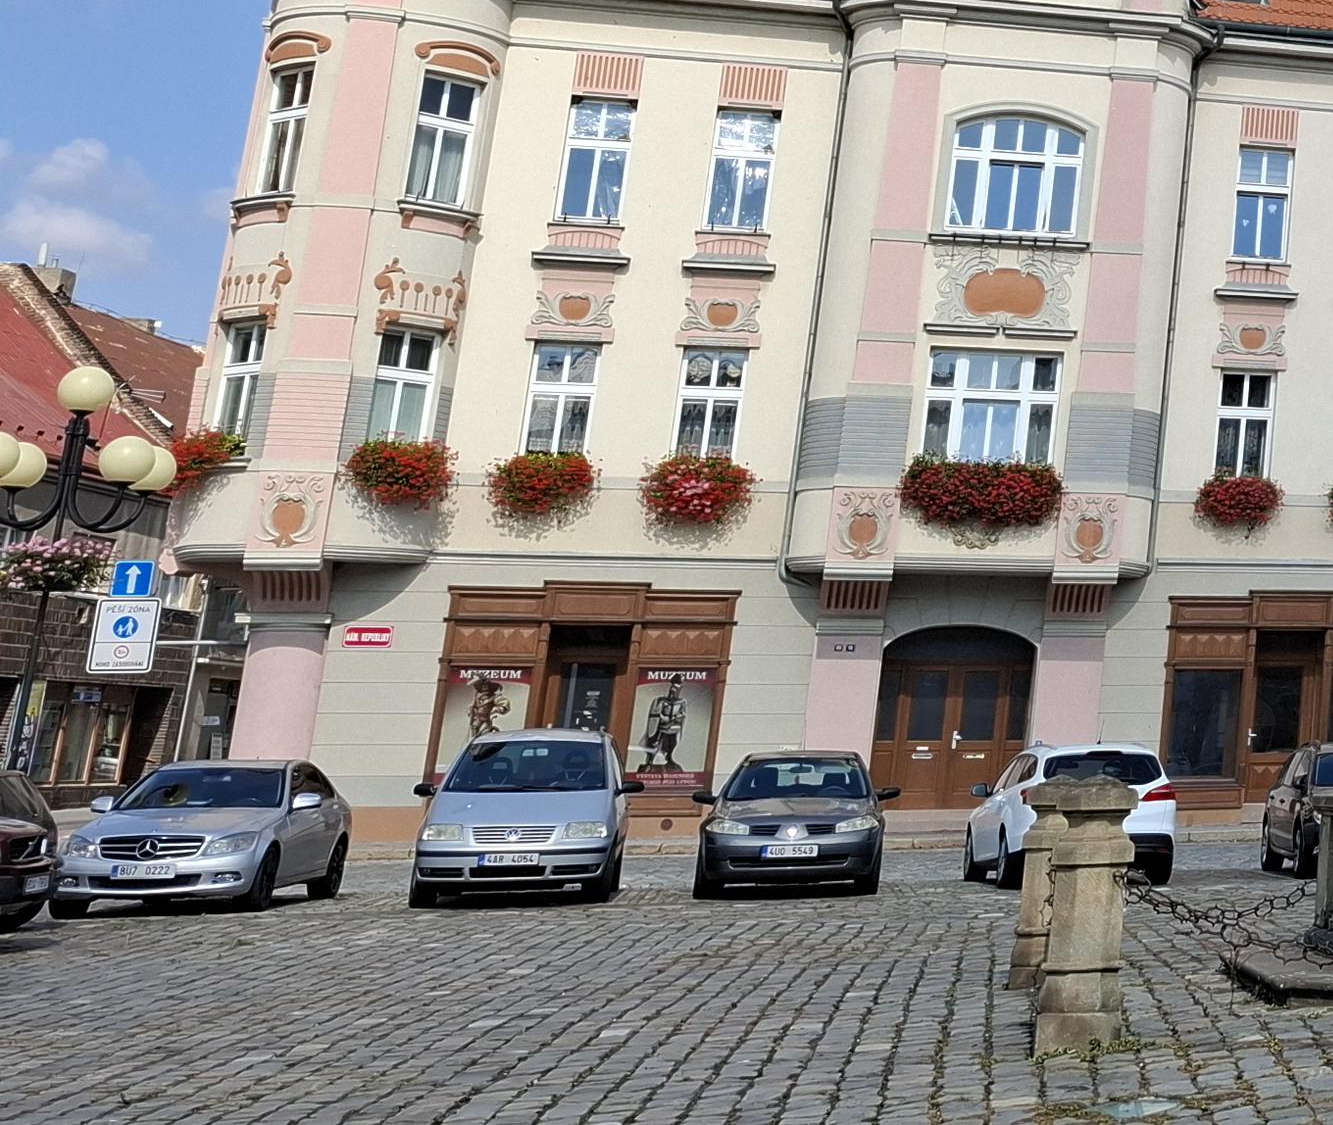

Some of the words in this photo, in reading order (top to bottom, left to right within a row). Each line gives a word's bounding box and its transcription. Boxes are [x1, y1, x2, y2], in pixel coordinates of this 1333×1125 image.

[487, 855, 505, 863] 4AR
[511, 855, 534, 863] 4054
[120, 866, 138, 876] 8U7
[145, 865, 170, 875] 0222
